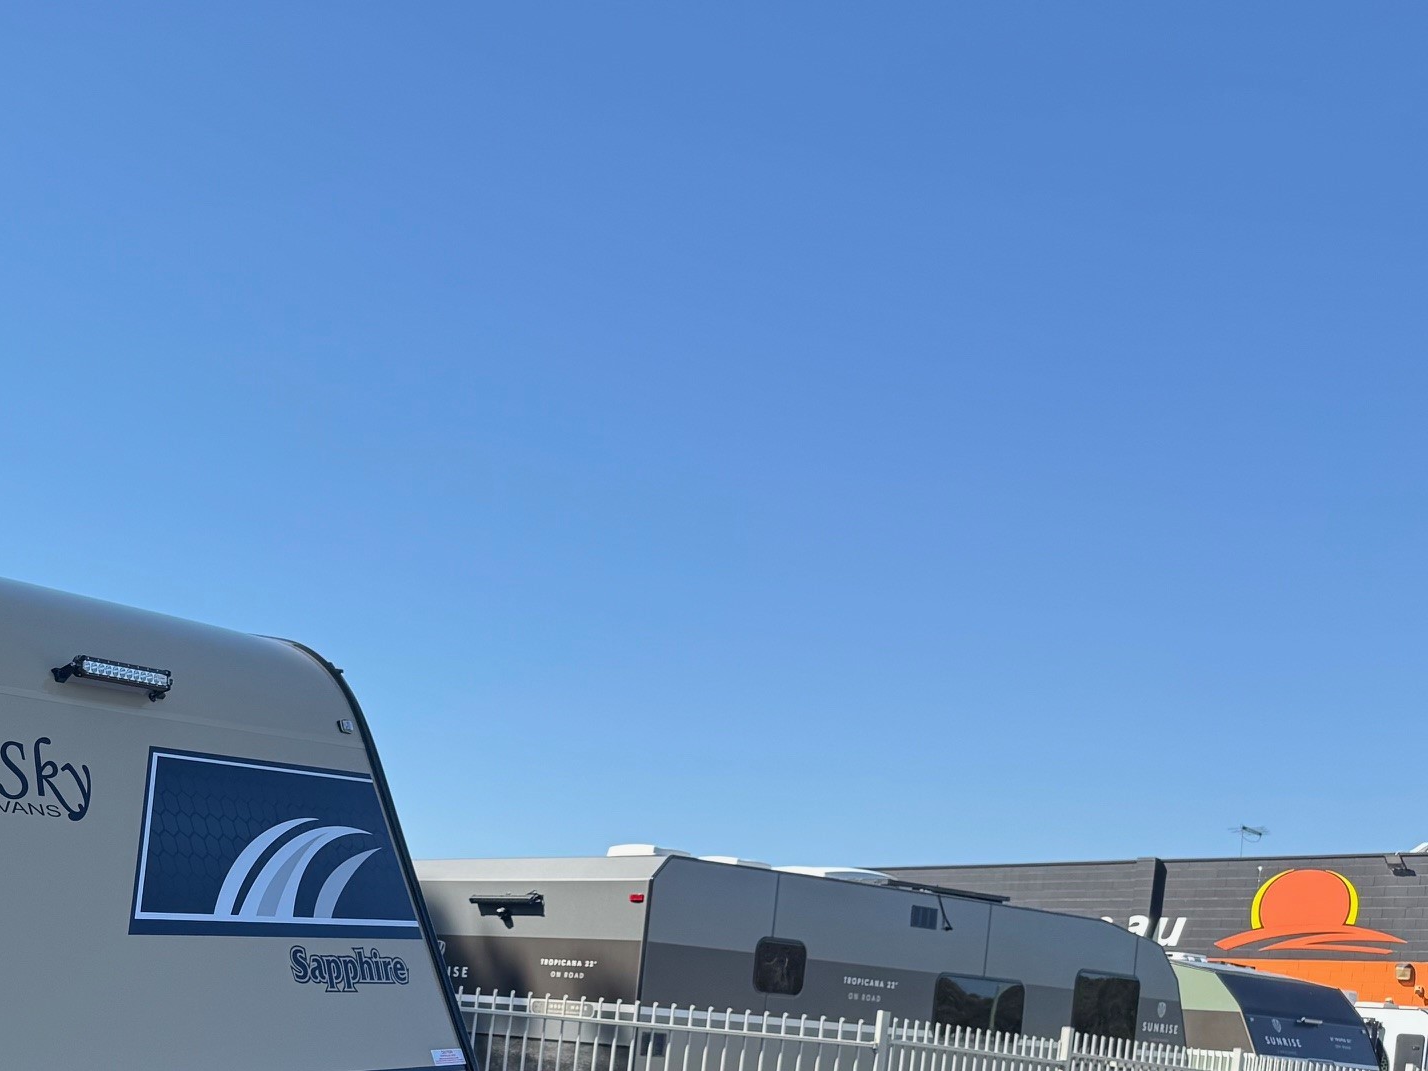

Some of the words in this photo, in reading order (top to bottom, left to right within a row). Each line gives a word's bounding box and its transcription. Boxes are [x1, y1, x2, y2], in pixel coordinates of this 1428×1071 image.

[540, 958, 582, 967] TROPICANA
[288, 944, 411, 994] Sapphire
[843, 976, 884, 988] TROPICANA
[847, 992, 859, 1000] ON
[861, 993, 882, 1003] ROAD
[1142, 1021, 1179, 1035] SUNRISE
[1264, 1035, 1302, 1048] SUNRISE
